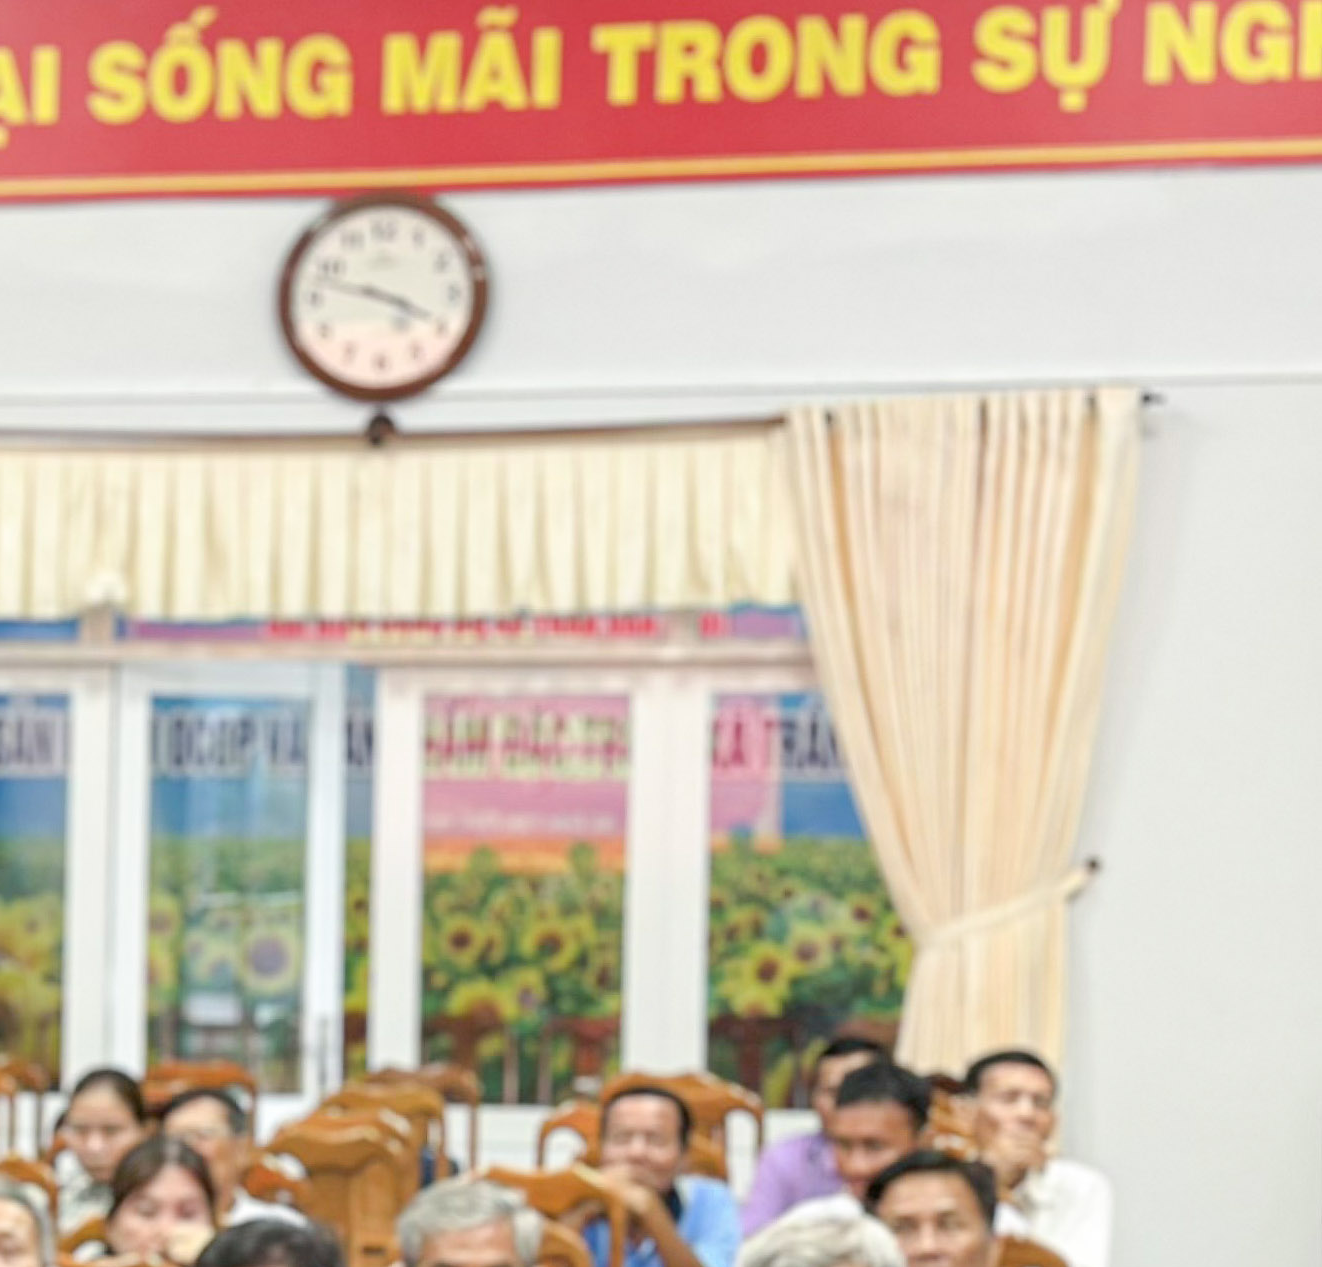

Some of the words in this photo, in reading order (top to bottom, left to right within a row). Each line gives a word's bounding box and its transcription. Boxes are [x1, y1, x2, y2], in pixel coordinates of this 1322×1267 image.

[87, 6, 352, 127] SỐNG
[381, 7, 562, 115] MÃI
[593, 11, 943, 106] TRONG
[973, 0, 1123, 112] SỰ
